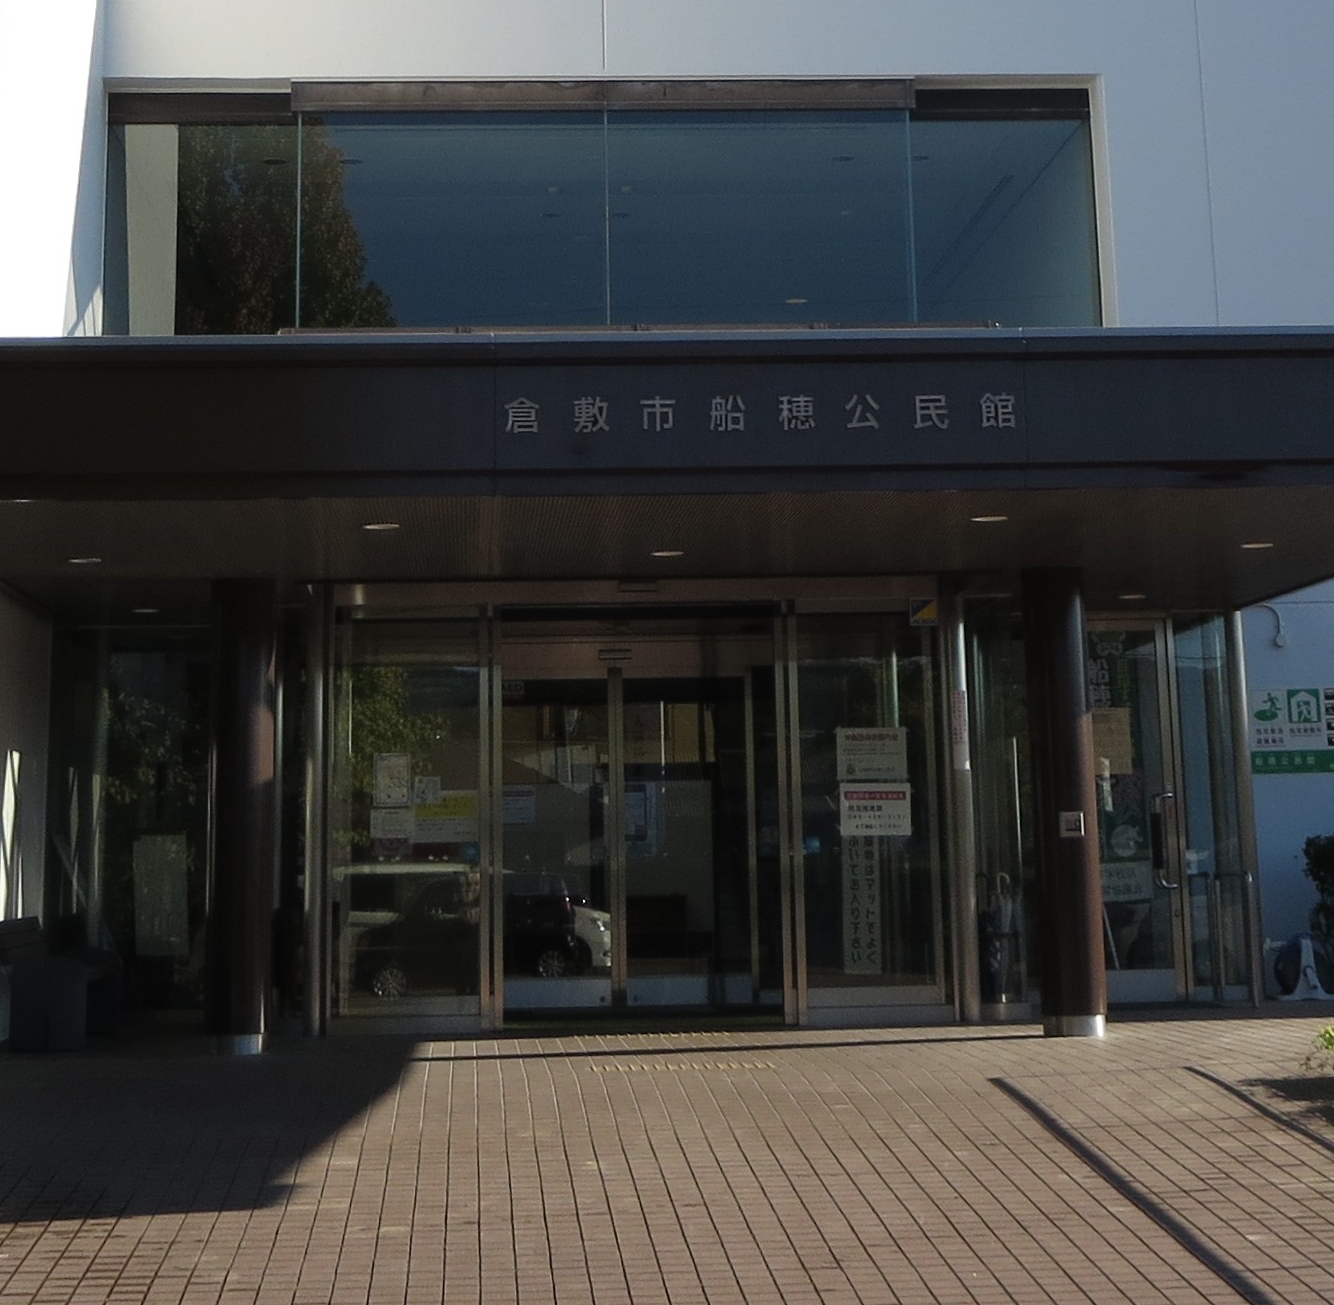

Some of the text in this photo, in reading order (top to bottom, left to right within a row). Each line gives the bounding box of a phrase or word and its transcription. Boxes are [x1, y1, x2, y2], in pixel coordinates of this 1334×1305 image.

[505, 393, 1016, 434] 倉敷市船穂公民館
